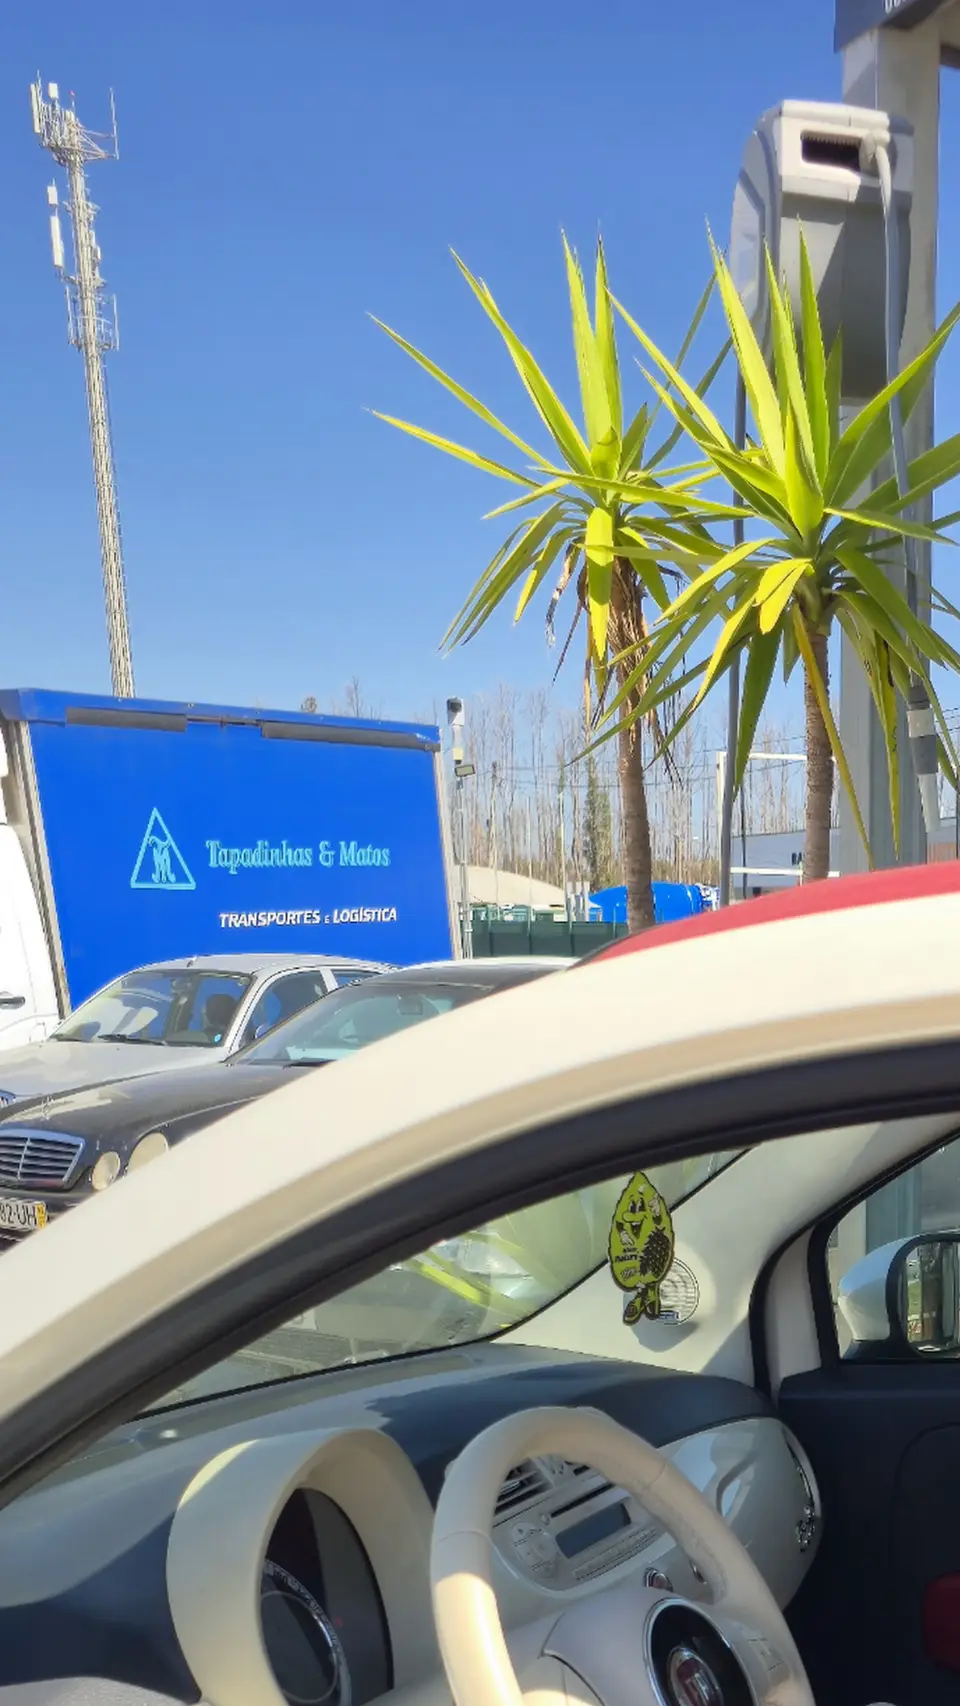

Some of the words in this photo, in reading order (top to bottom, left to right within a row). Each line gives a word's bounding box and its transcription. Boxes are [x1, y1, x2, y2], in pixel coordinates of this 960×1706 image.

[206, 840, 313, 874] Tapadinhas
[318, 840, 335, 868] &
[339, 841, 392, 867] Matos
[219, 909, 321, 928] TRANSPORTES
[324, 915, 330, 924] E
[333, 906, 397, 924] LOGÍSTICA
